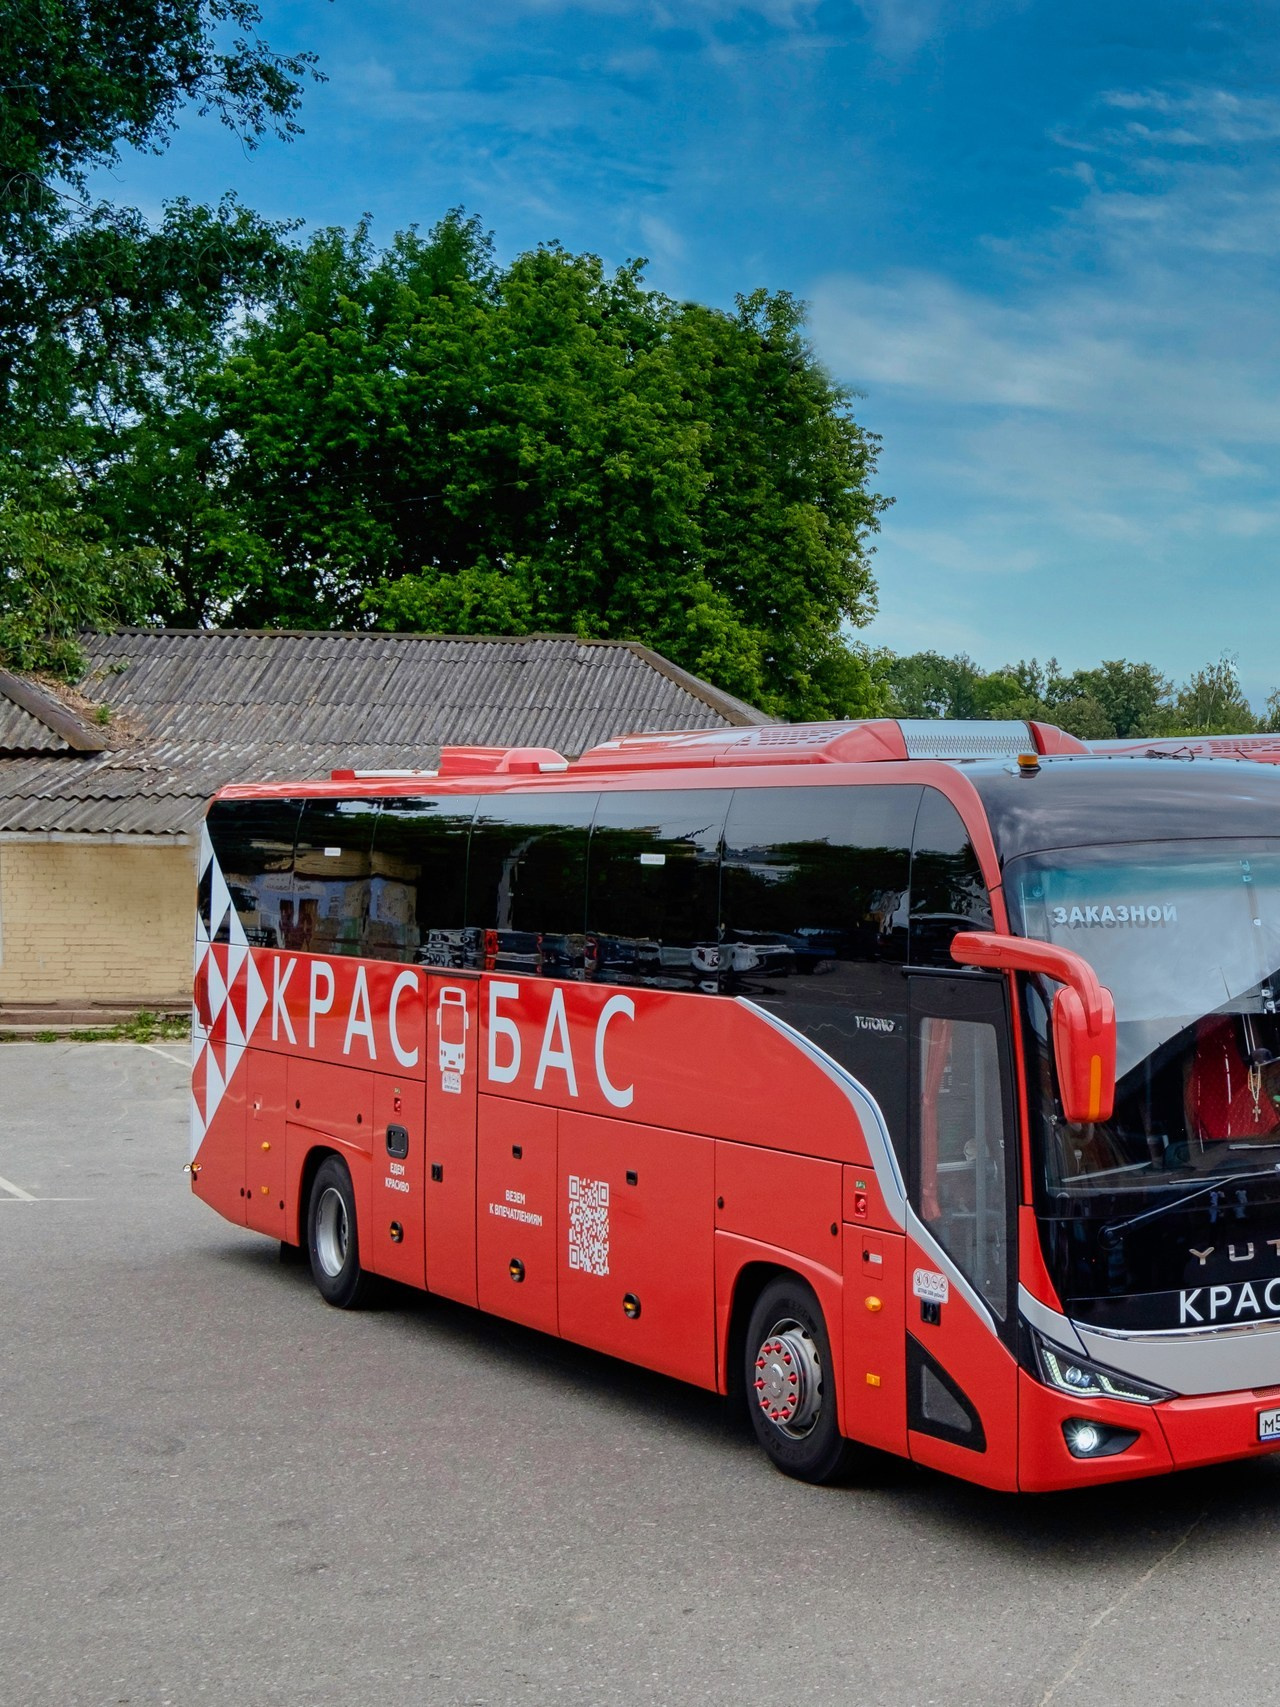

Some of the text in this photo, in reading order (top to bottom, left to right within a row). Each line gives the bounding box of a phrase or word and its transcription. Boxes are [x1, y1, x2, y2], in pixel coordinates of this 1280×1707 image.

[1053, 903, 1178, 923] ЗАКАЗНОЙ
[272, 956, 635, 1108] КРАС БАС
[855, 1016, 896, 1032] YUTONG
[505, 1189, 526, 1205] ВЕЗЕМ
[494, 1204, 543, 1227] ВПЕЧАТЛЕНИЯМ
